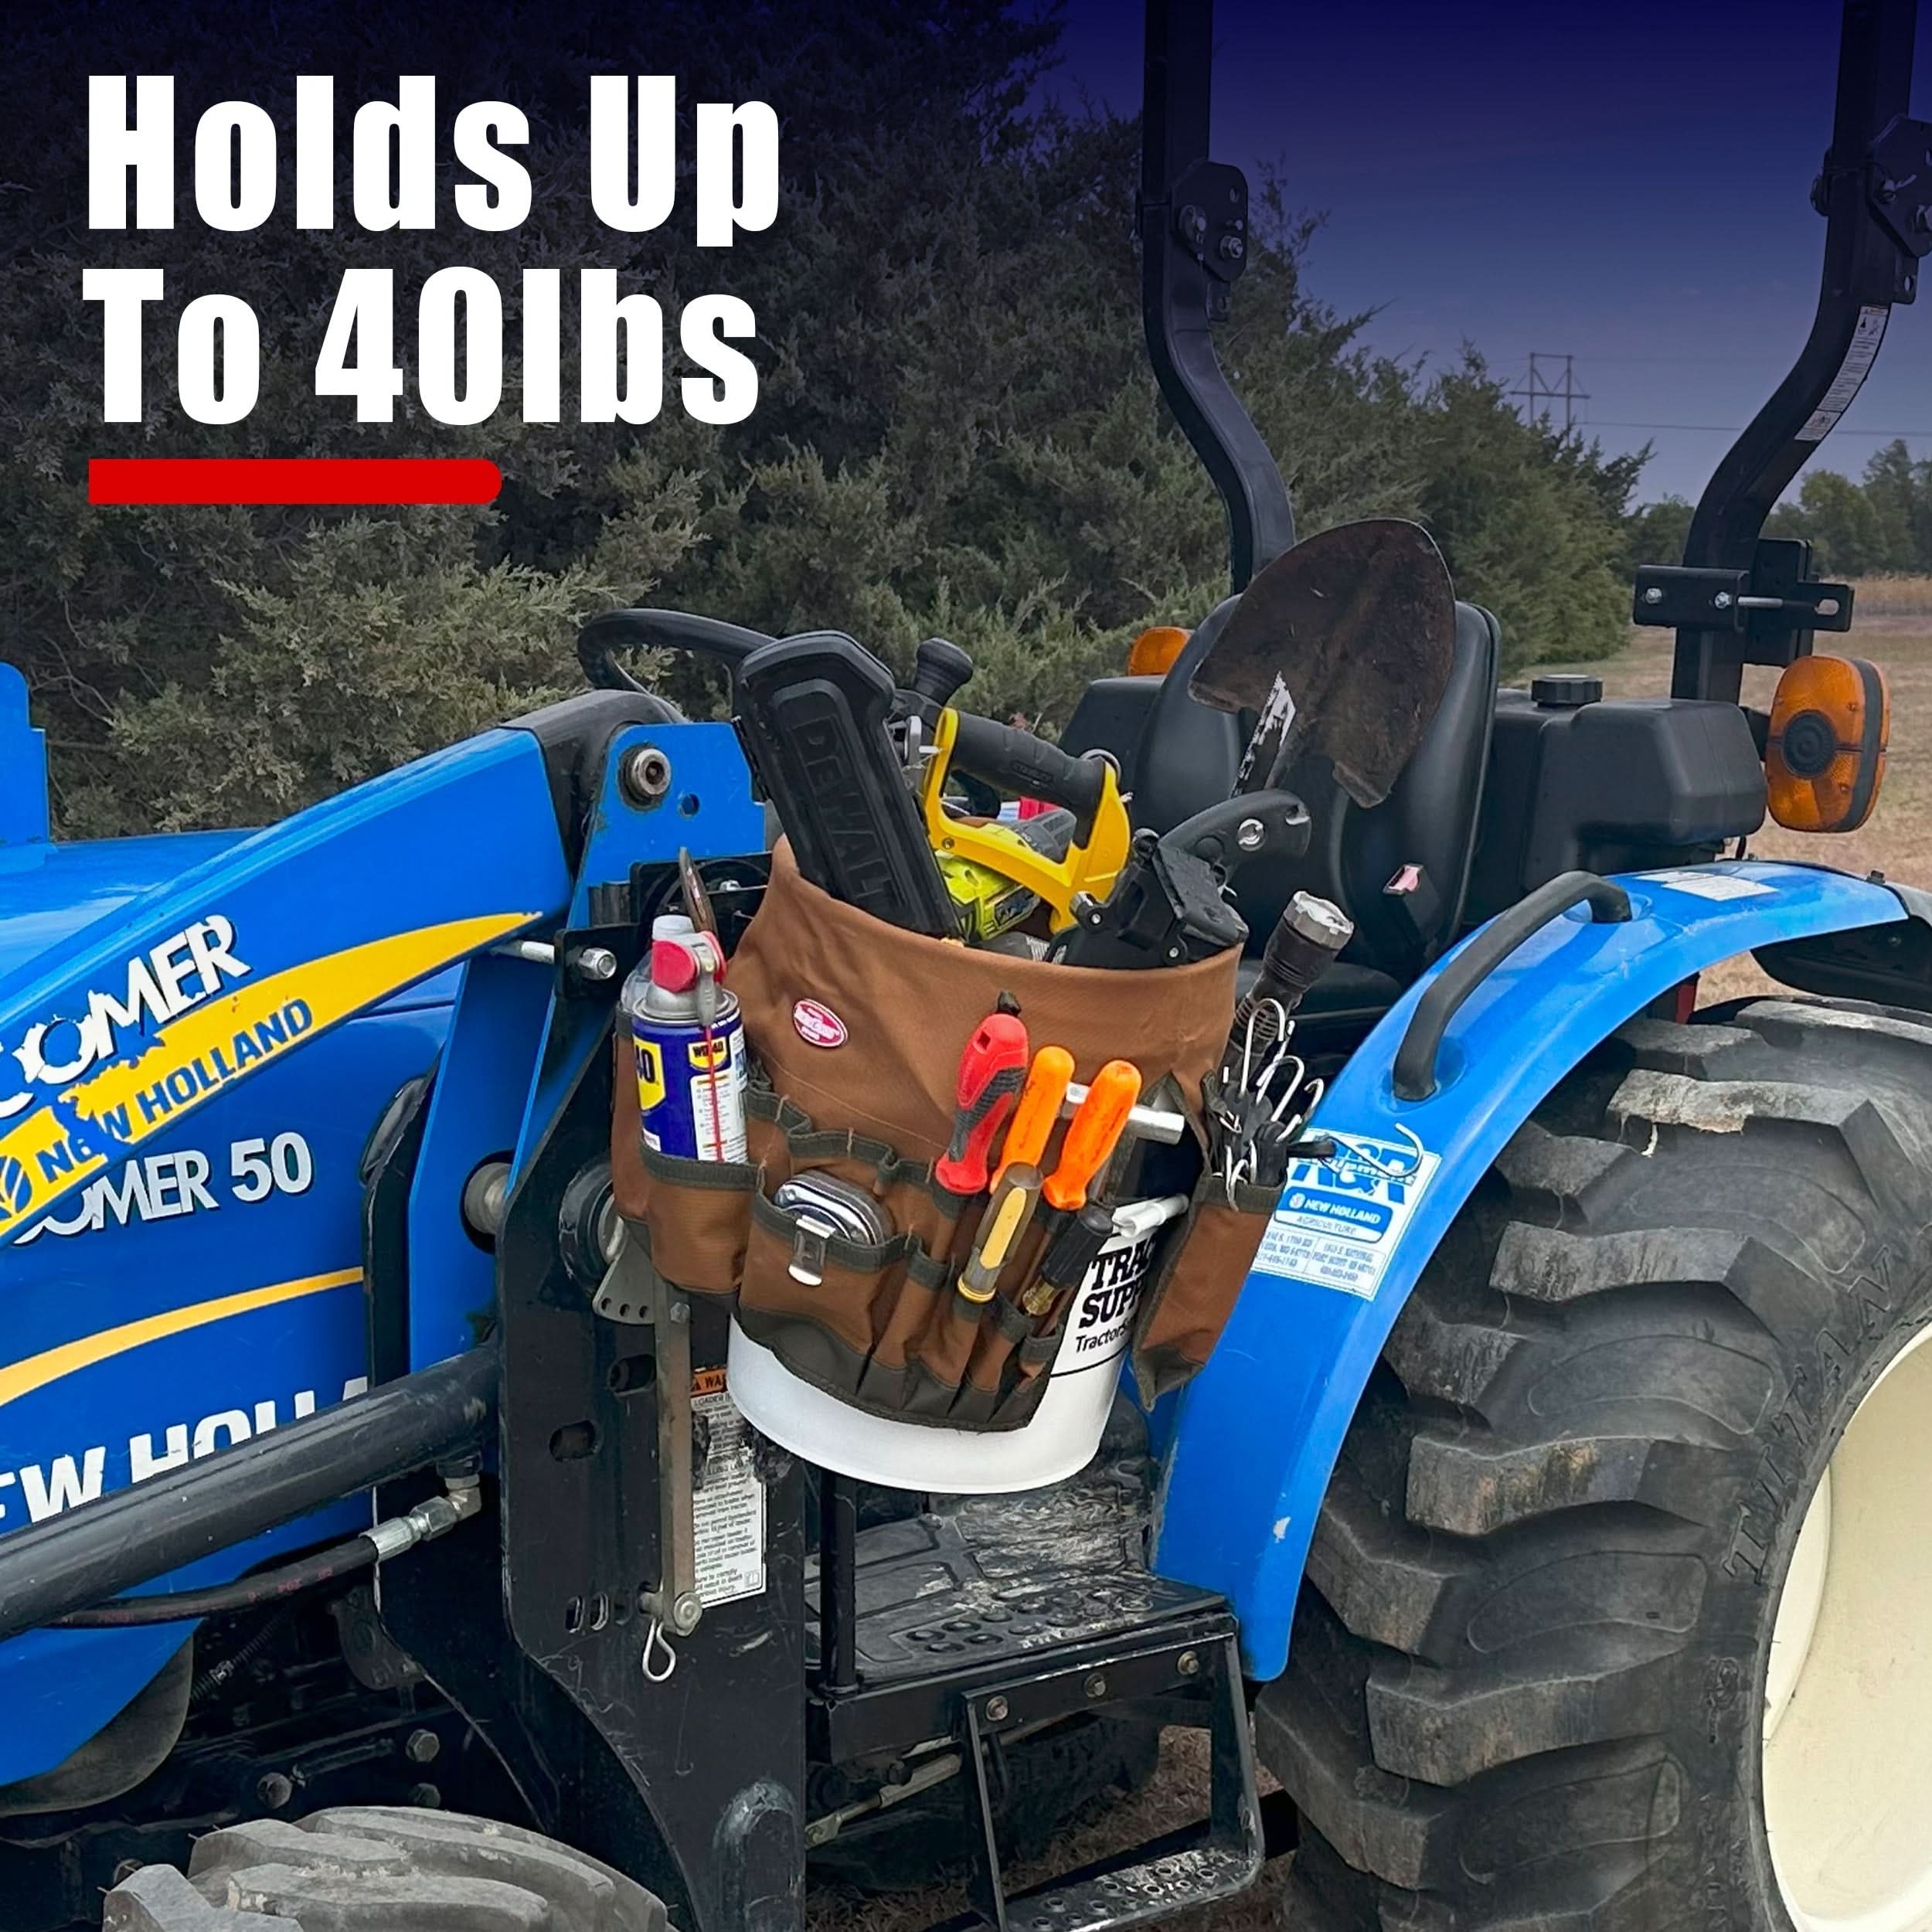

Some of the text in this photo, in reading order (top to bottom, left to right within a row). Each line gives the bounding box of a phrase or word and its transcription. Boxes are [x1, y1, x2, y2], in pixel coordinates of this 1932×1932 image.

[135, 998, 313, 1123] HOLLAND
[231, 1131, 312, 1202] 50
[1304, 1198, 1382, 1224] NEW HOLLAND
